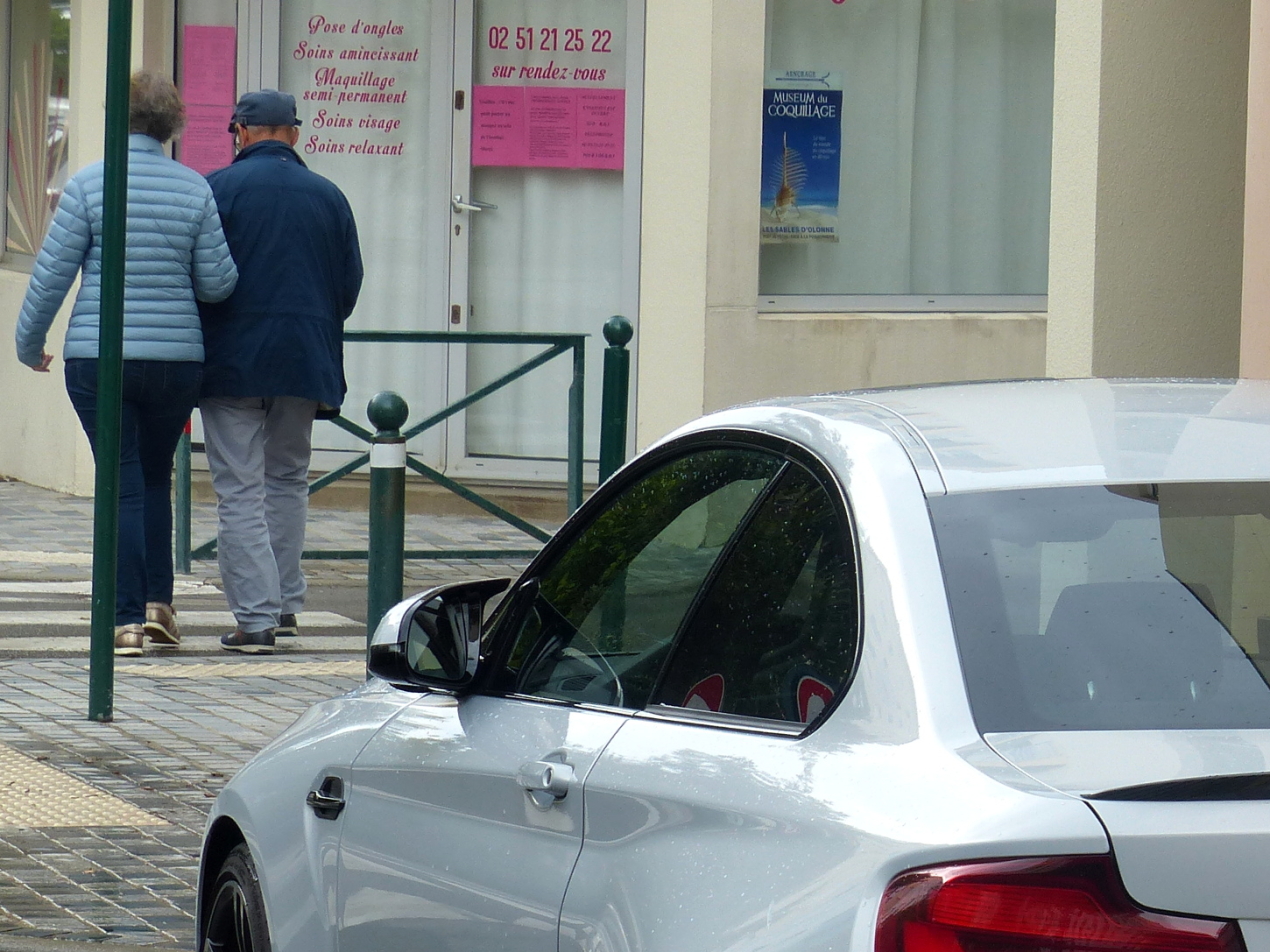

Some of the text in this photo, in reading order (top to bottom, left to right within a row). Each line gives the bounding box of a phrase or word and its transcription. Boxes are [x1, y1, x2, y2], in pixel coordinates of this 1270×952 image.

[308, 15, 404, 39] Pose d'ongles
[488, 26, 612, 53] 02 51 21 25 22
[293, 40, 419, 62] Soins amincissant
[314, 67, 396, 91] Maquillage
[491, 60, 606, 81] sur rendez-vous
[303, 87, 407, 105] semi-permanent
[773, 91, 828, 104] MUSEUM du
[312, 109, 401, 133] Soins visage
[768, 103, 836, 119] COQUILLAGE
[304, 134, 404, 156] Soins relaxant
